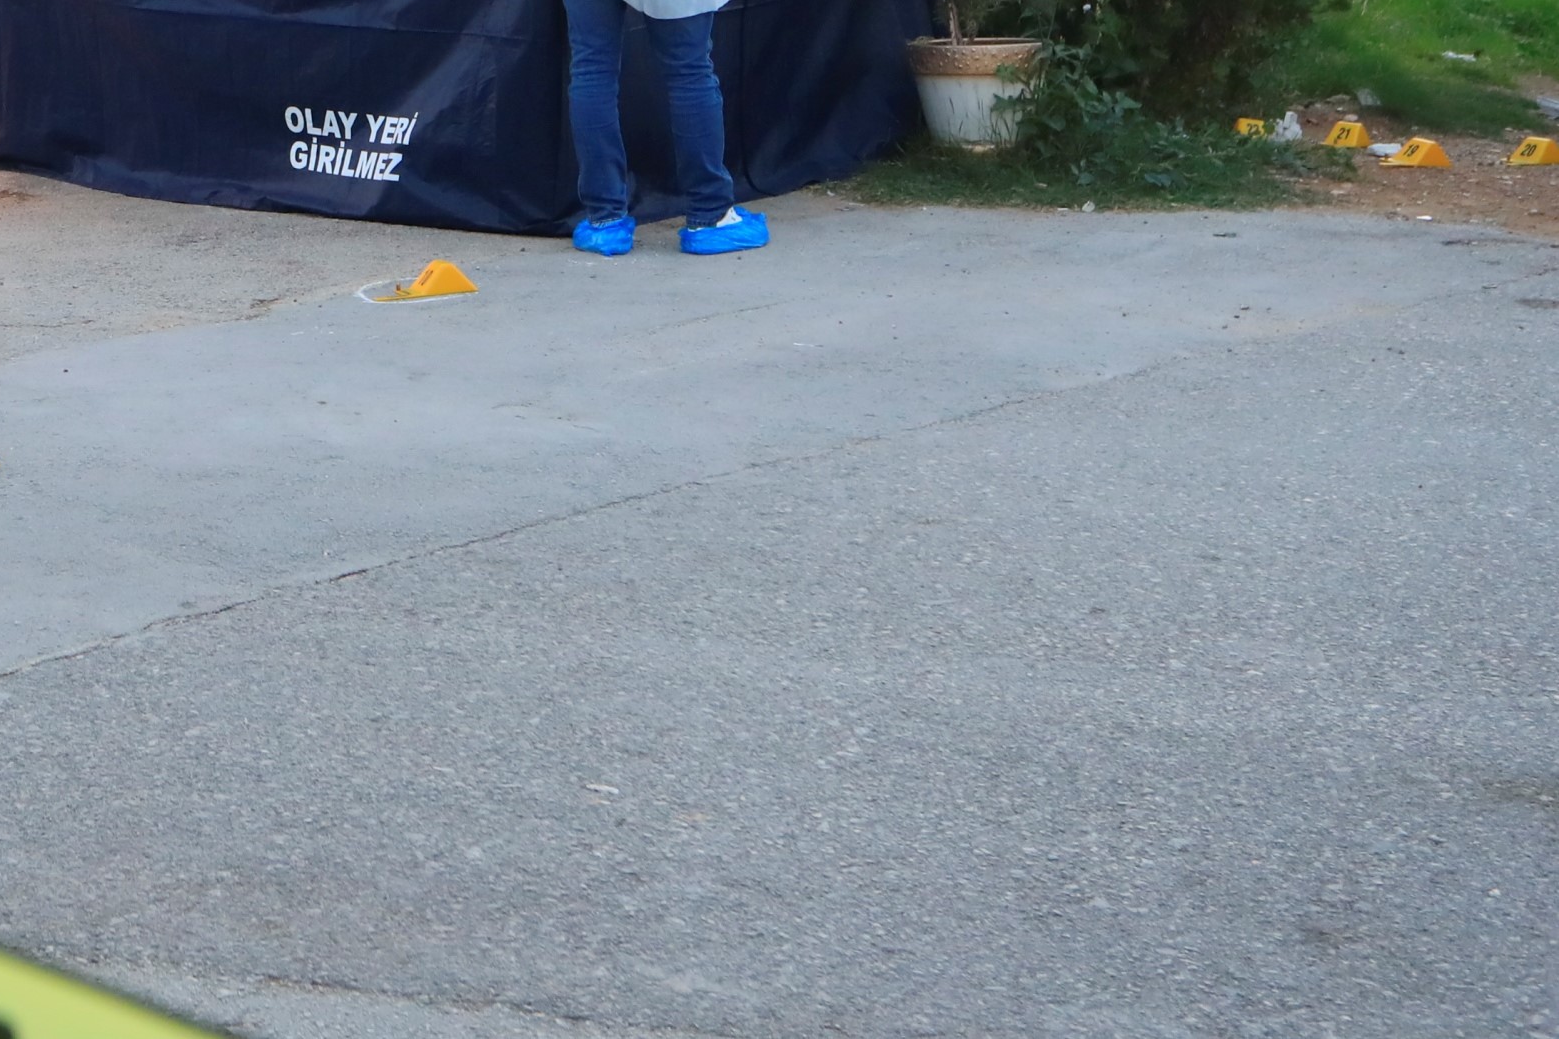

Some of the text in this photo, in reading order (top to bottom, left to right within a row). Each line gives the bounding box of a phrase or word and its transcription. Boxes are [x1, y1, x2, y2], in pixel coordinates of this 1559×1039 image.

[285, 106, 419, 146] OLAY YERİ
[1337, 127, 1351, 140] 21
[1403, 144, 1420, 158] 19
[1521, 143, 1537, 157] 20
[290, 137, 403, 182] GİRİLMEZ
